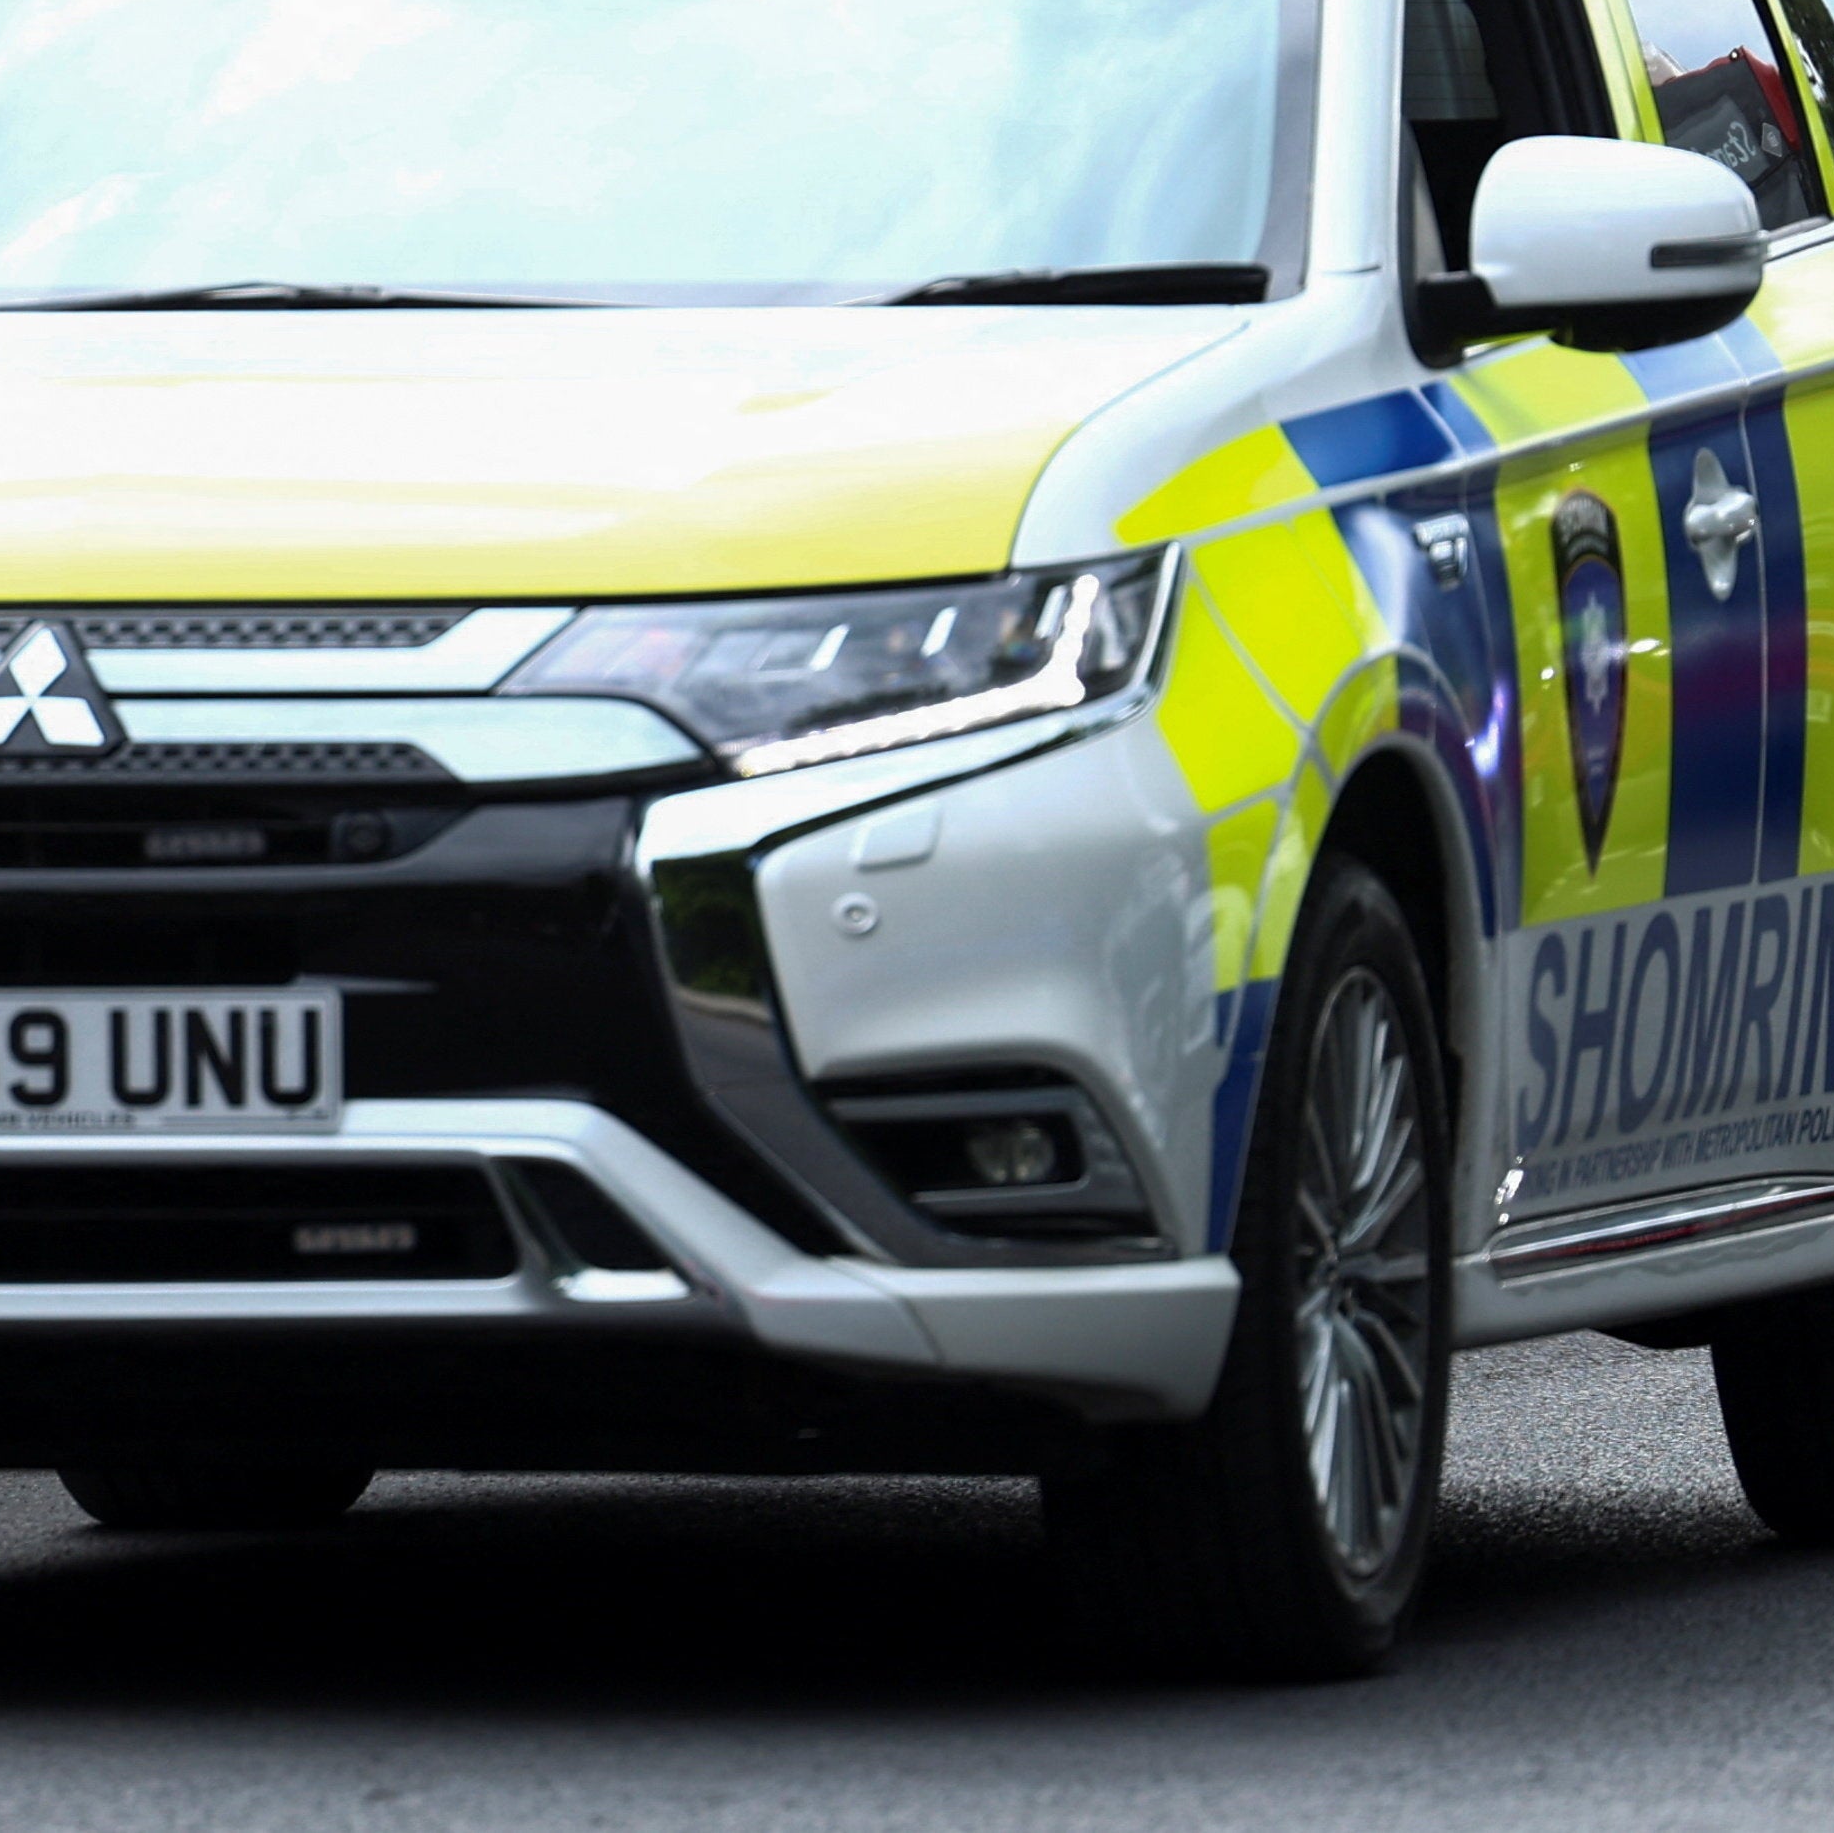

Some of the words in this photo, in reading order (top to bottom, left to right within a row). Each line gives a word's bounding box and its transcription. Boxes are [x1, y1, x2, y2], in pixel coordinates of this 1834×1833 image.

[109, 1006, 322, 1109] UNU
[1661, 1130, 1695, 1170] WITH
[1693, 1112, 1801, 1164] METROPOLITAN
